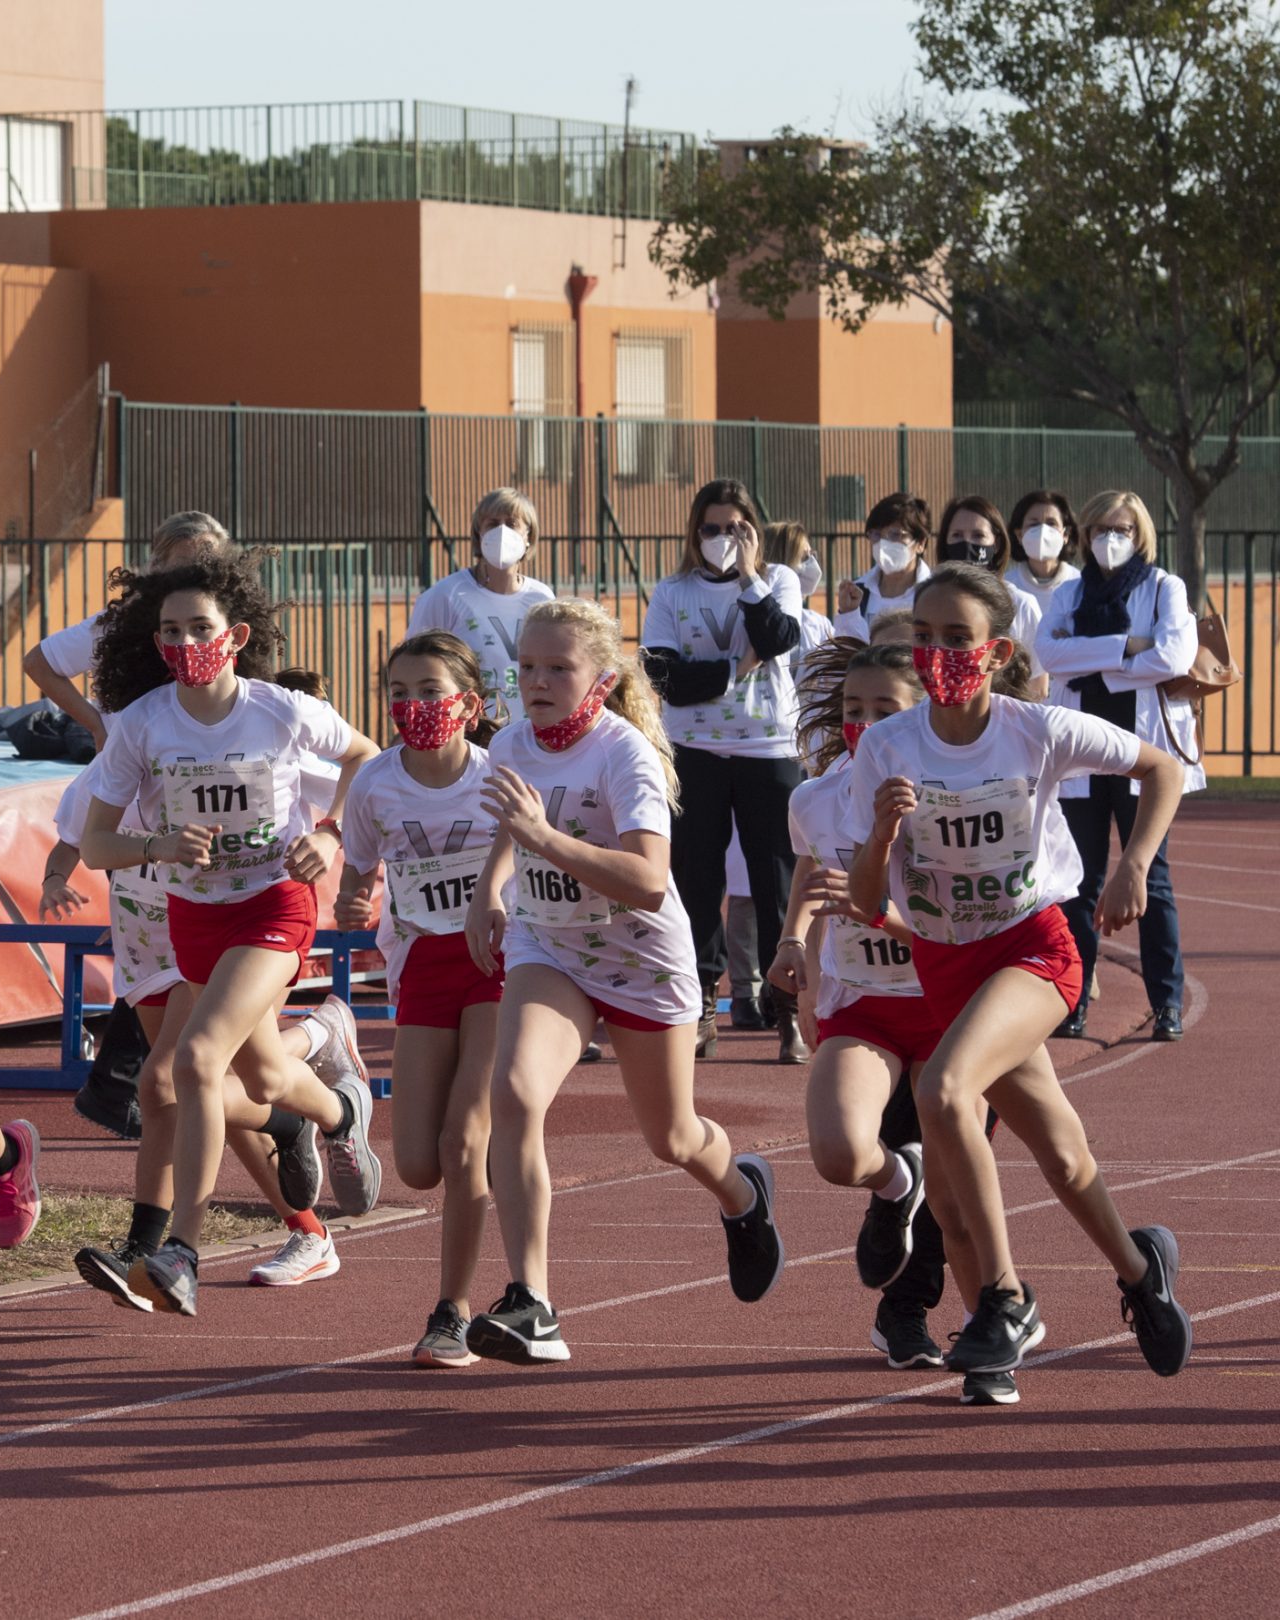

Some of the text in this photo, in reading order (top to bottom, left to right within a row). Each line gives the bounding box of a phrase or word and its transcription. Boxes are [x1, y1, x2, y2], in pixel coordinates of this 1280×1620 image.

[699, 604, 739, 651] V
[192, 764, 215, 773] aecc
[191, 784, 248, 813] 1171
[937, 793, 961, 802] aecc
[935, 810, 1004, 848] 1179
[419, 860, 441, 870] aecc
[951, 860, 1036, 901] aecc
[419, 873, 478, 913] 1175
[526, 868, 581, 903] 1168
[955, 901, 998, 912] Castelló
